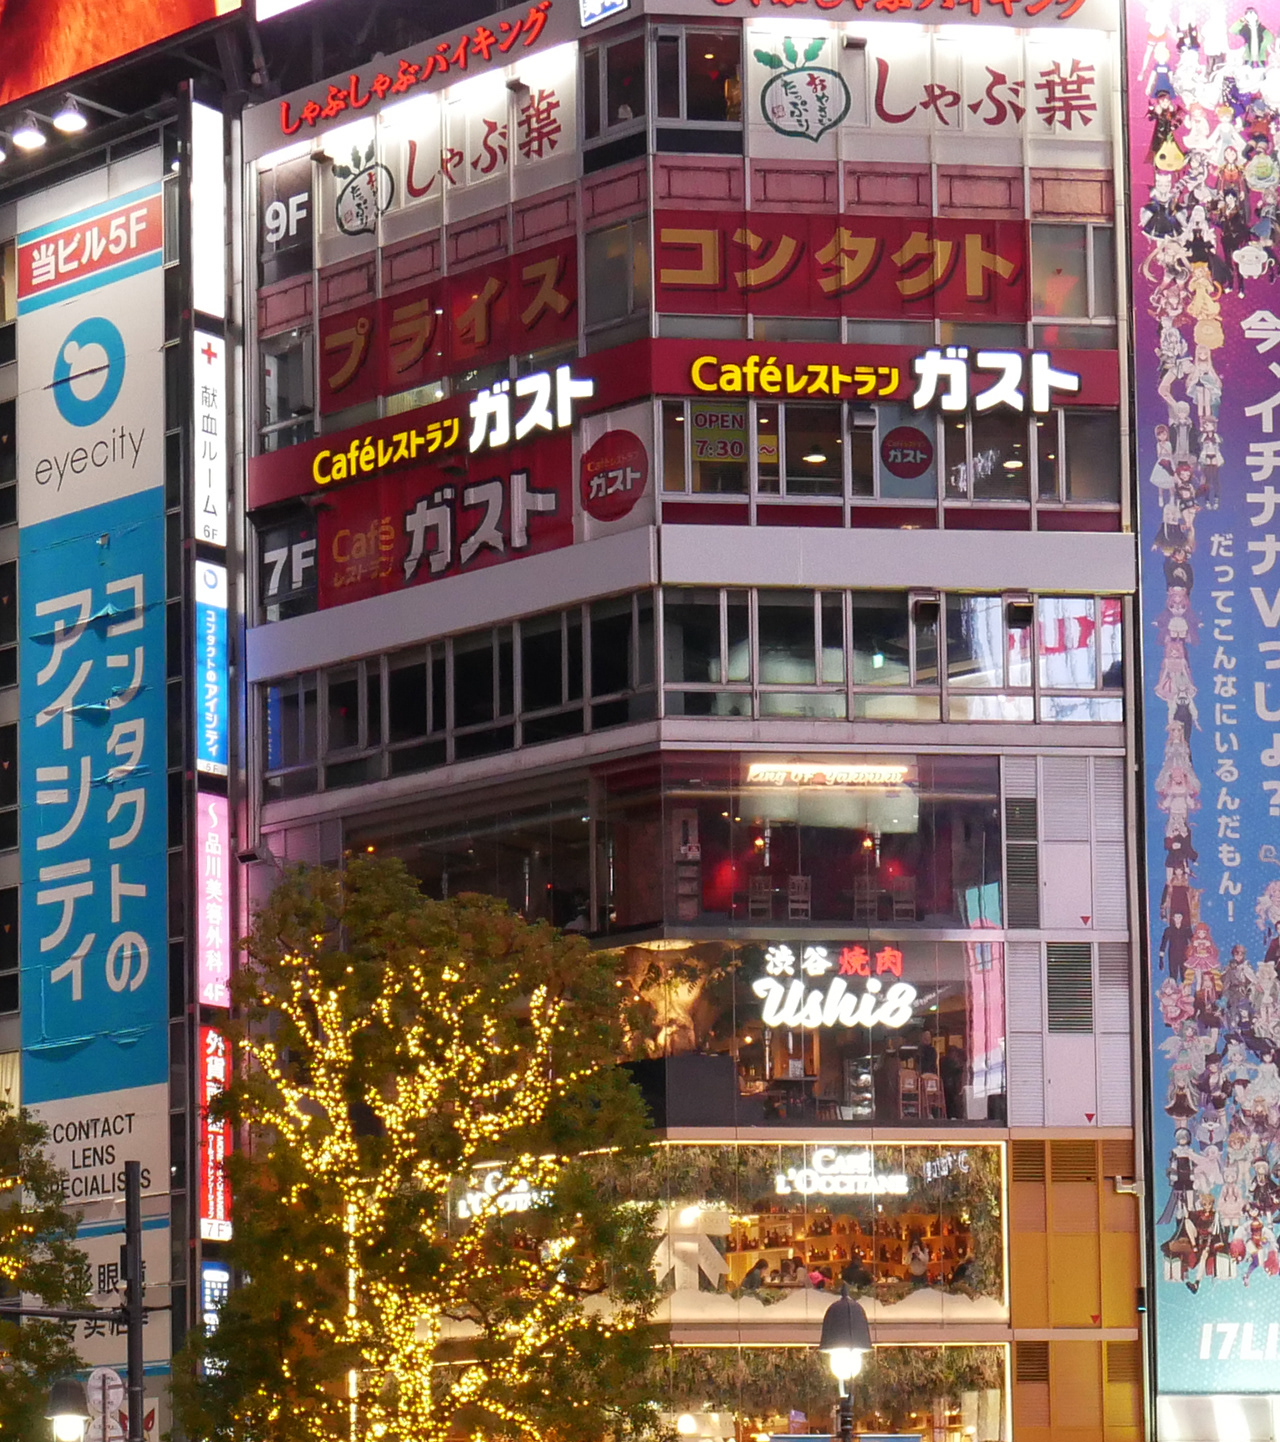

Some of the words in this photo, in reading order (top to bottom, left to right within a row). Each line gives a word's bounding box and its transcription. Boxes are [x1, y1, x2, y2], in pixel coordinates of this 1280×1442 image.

[279, 2, 551, 135] しゃぶしゃぶバイキング
[875, 57, 1099, 132] しゃぶ葉
[406, 88, 563, 199] しゃぶ葉
[264, 191, 309, 243] 9F
[30, 218, 150, 285] 当ビル5F
[659, 227, 1017, 301] コンタクト
[323, 254, 575, 393] プライス
[691, 354, 900, 397] Caféレストラン
[912, 345, 1081, 413] ガスト
[200, 385, 218, 517] 献血ルーム
[312, 416, 460, 485] Caféレストラン
[469, 365, 595, 453] ガスト
[693, 412, 745, 431] OPEN
[695, 437, 745, 458] 7:30
[34, 423, 146, 494] eyecity
[589, 469, 642, 500] ガスト
[888, 449, 928, 464] ガスト
[203, 524, 218, 540] 6F
[332, 516, 395, 564] Café
[404, 473, 557, 581] ガスト
[263, 538, 317, 597] 7F
[35, 588, 95, 1002] アイシティ
[105, 573, 150, 993] コンタクトの
[204, 831, 224, 972] 品川美容外科
[203, 982, 225, 1001] 4F
[764, 944, 833, 978] 渋谷
[837, 946, 905, 977] 焼肉
[52, 1112, 136, 1144] CONTACT
[71, 1144, 116, 1171] LENS
[206, 1221, 225, 1238] 7F
